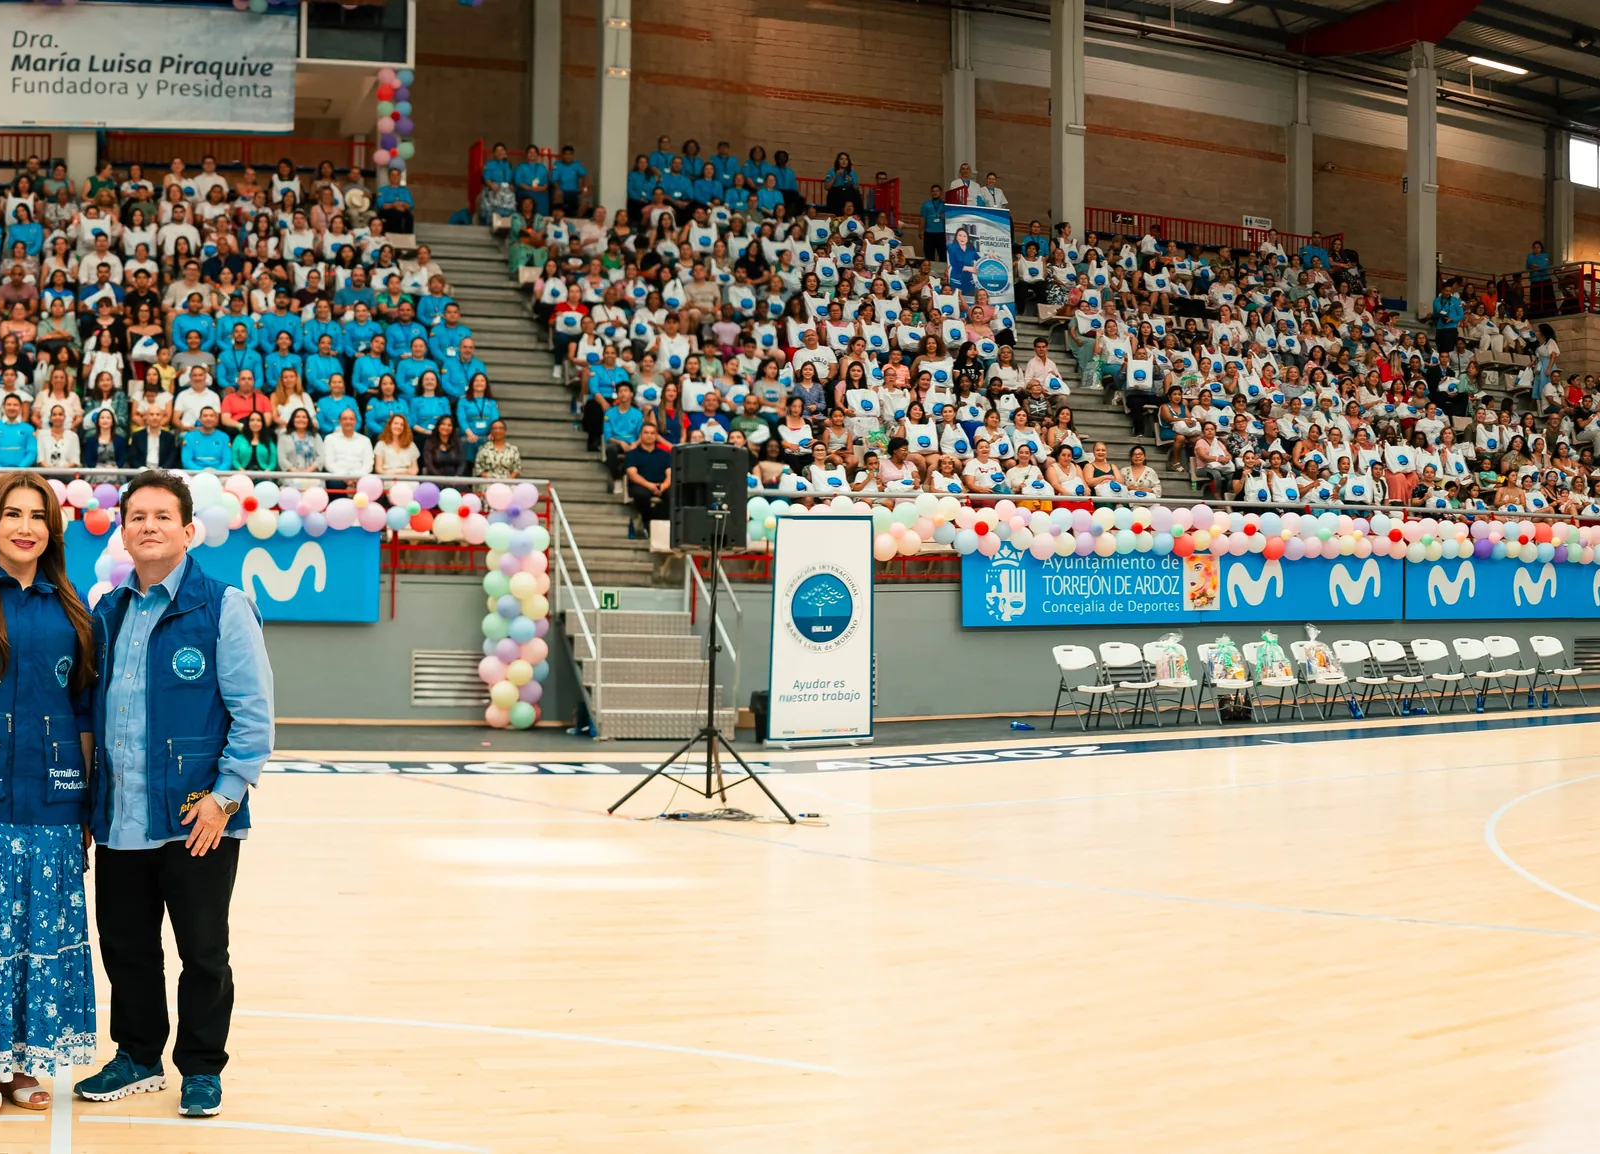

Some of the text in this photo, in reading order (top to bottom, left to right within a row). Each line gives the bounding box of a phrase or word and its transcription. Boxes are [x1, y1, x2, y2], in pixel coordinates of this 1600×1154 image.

[12, 30, 59, 48] Dra.
[10, 52, 273, 81] María Luisa Piraquive
[12, 77, 273, 100] Fundadora y Presidenta
[1042, 555, 1180, 572] Ayuntamiento de
[1042, 568, 1180, 599] TORREJÓN DE ARDOZ
[1042, 599, 1180, 616] Concejalía de Deportes
[793, 679, 845, 692] Ayudar es
[779, 689, 861, 703] nuestro trabajo
[49, 768, 80, 777] Familias
